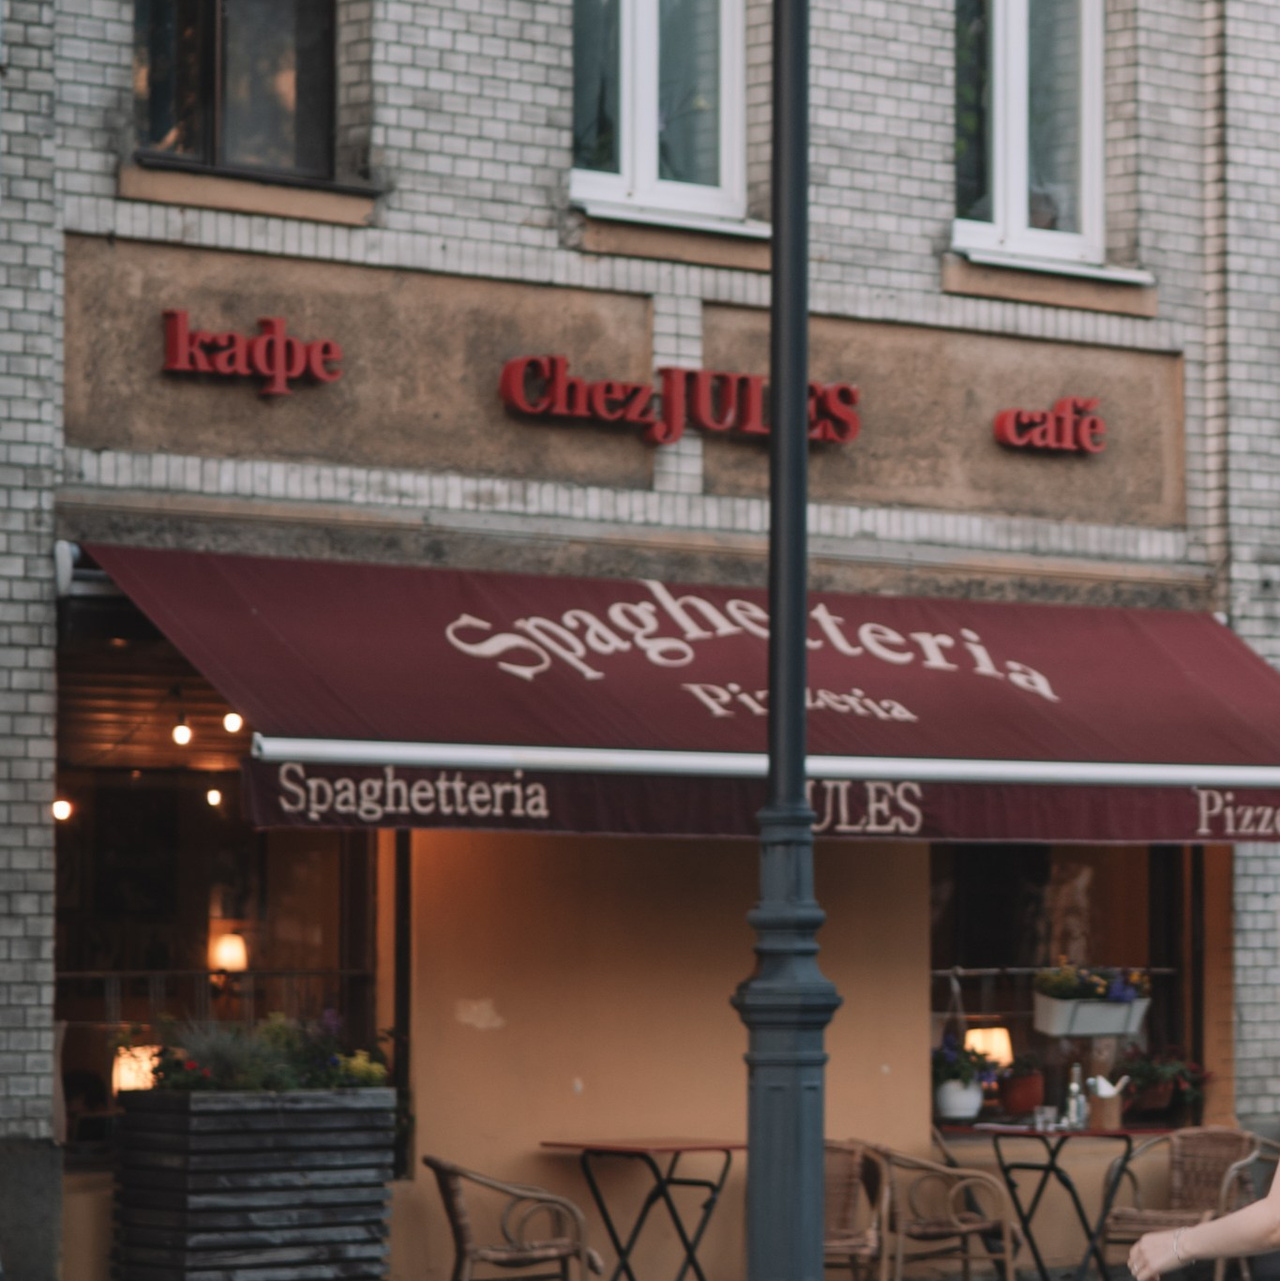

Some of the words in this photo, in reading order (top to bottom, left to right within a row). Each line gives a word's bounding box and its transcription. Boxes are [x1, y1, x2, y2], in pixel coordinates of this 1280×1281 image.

[162, 310, 344, 395] кафе
[500, 355, 655, 424] Chez
[993, 396, 1107, 454] café
[445, 579, 1060, 702] Spagheteria
[681, 682, 918, 722] Pieria
[278, 762, 551, 821] Spaghetteria
[805, 779, 923, 835] ULES
